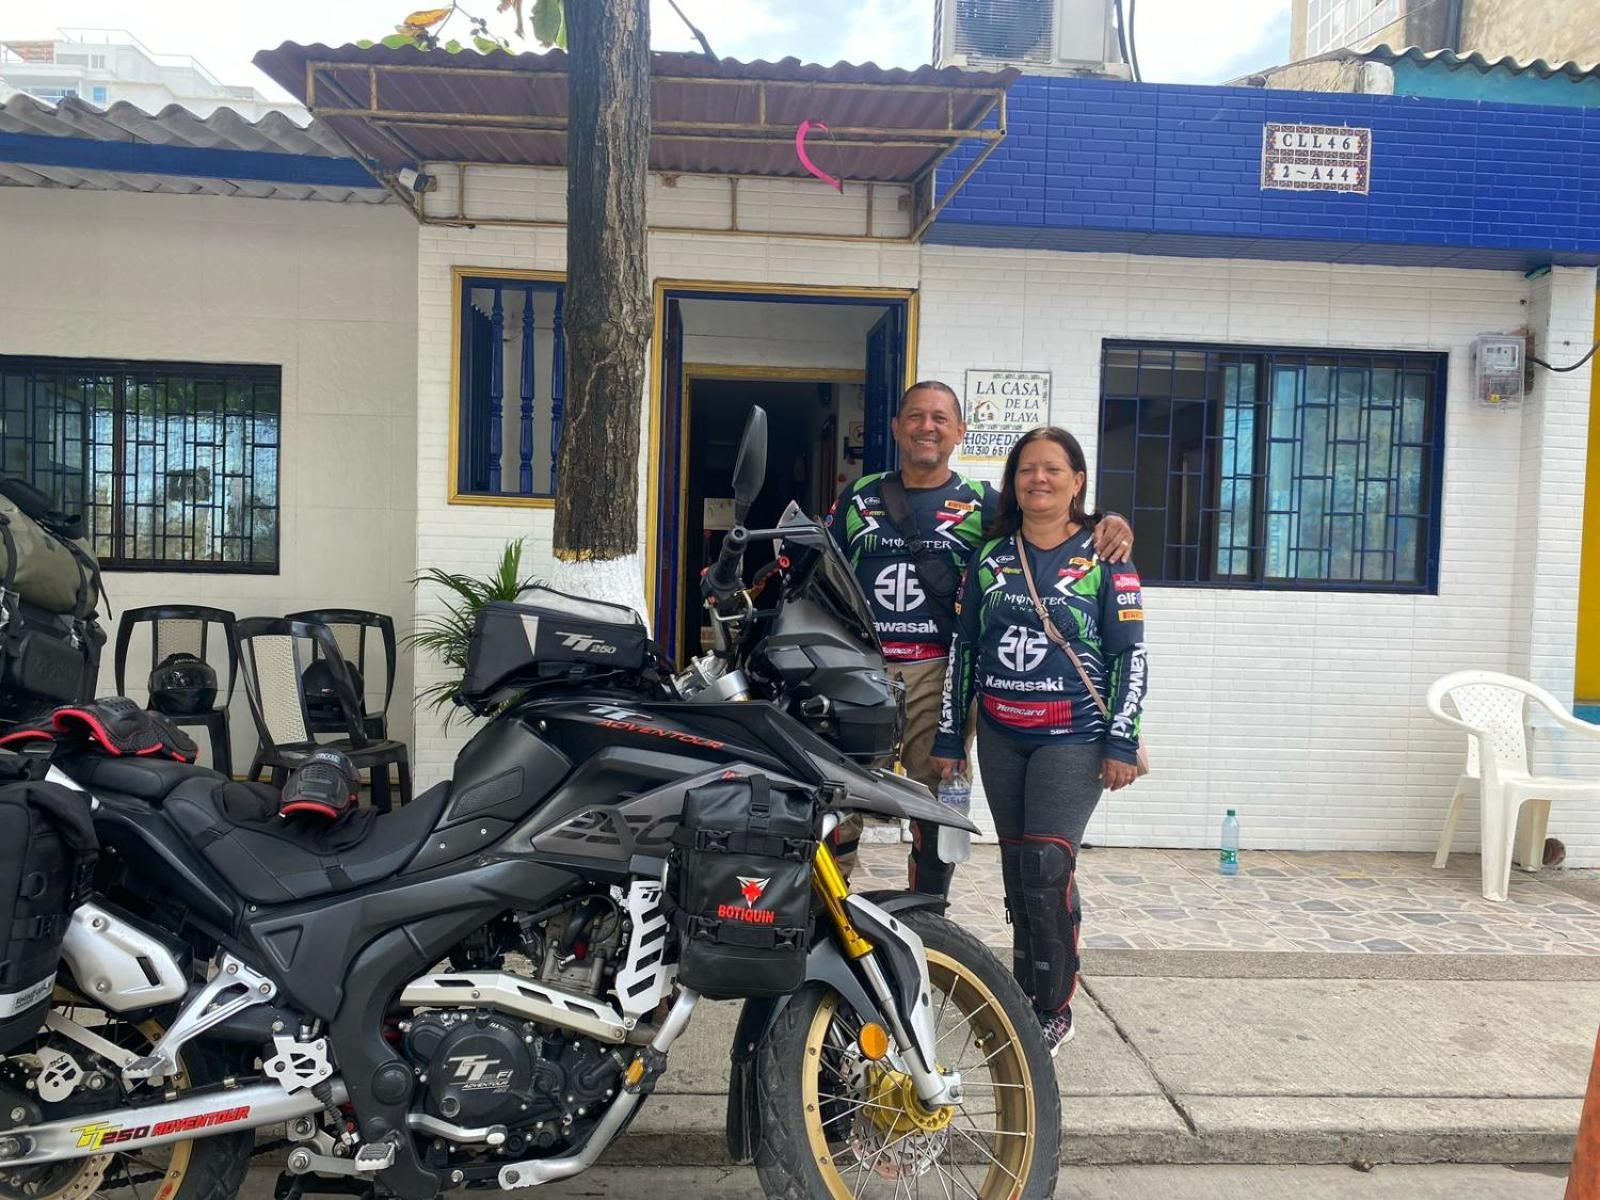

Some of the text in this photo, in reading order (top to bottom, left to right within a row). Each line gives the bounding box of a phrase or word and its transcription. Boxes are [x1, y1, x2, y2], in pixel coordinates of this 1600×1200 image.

[976, 381, 1040, 396] LA CASA
[1005, 398, 1039, 410] DE LA
[1003, 412, 1039, 422] PLAYA
[964, 433, 1020, 446] HOSPEDA
[1117, 593, 1136, 605] elf
[873, 620, 938, 634] awasak
[985, 674, 1064, 692] Kawasaki
[598, 719, 724, 749] ADVENTOUR
[718, 903, 775, 923] BOTIQUIN
[151, 1105, 250, 1137] ADVENTOUR
